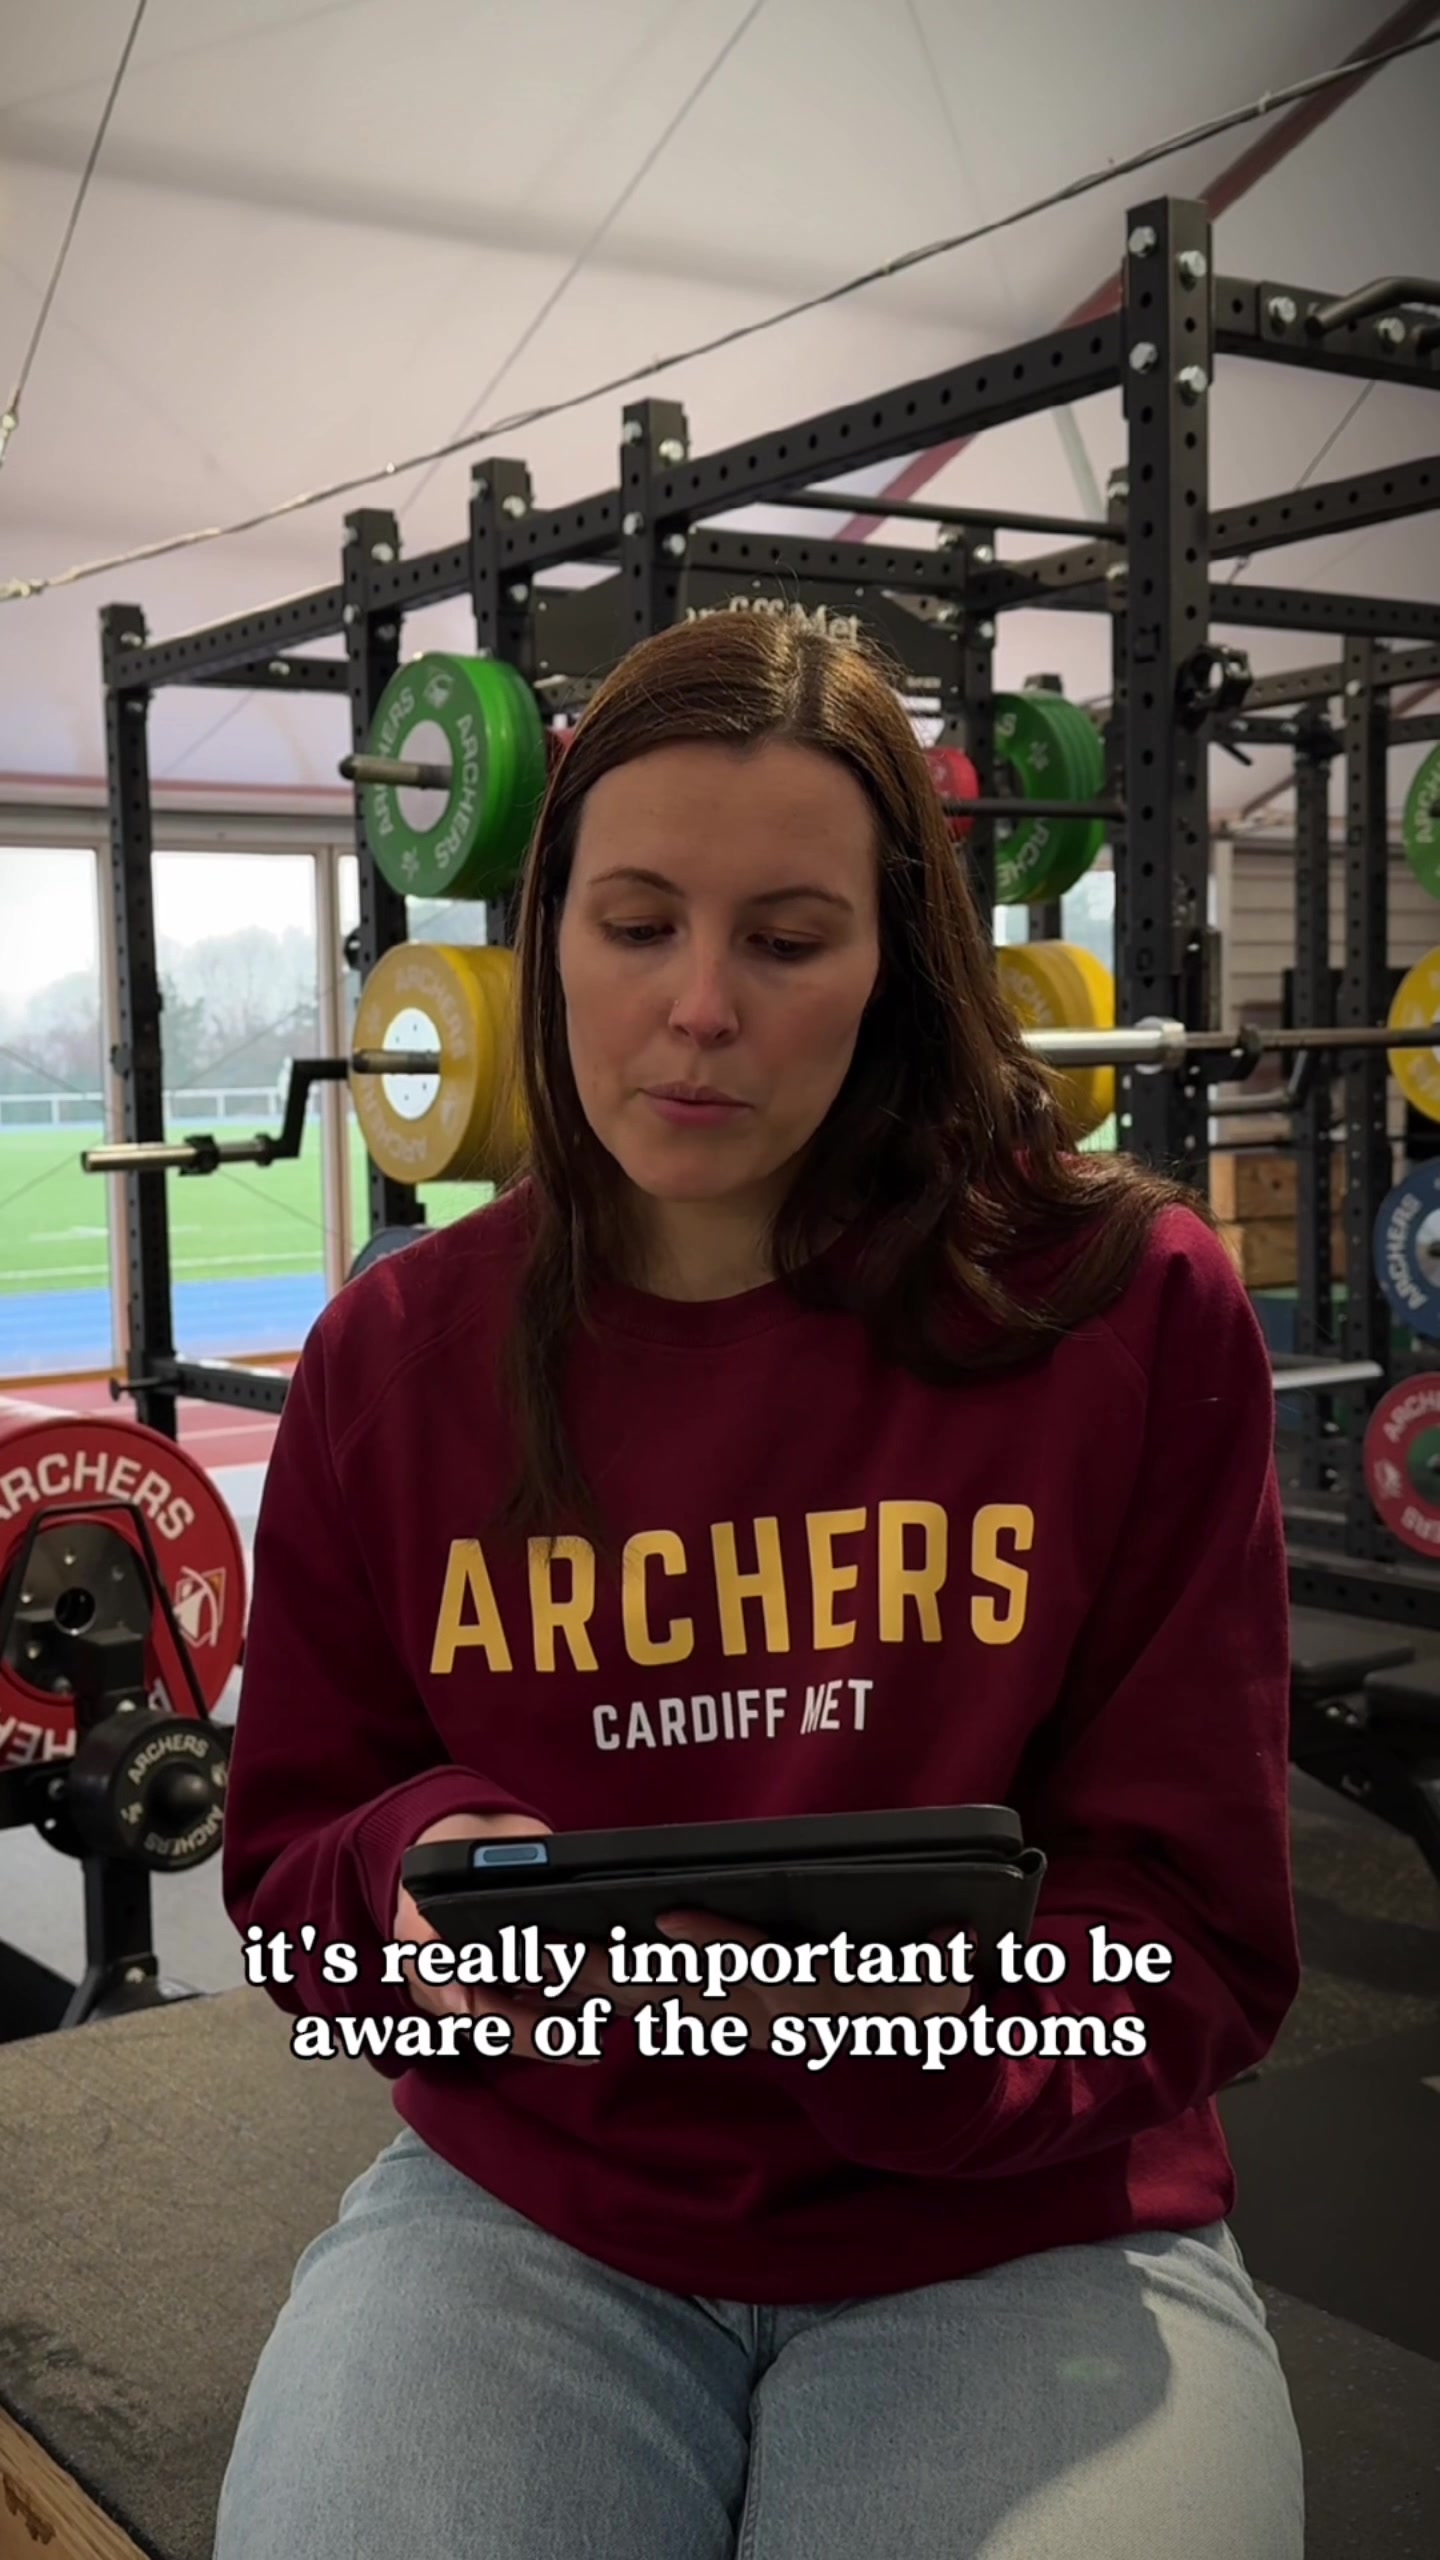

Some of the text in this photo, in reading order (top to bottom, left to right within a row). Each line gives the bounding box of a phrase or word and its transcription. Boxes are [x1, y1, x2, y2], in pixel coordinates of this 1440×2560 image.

[434, 714, 480, 870] ARCHERS
[429, 1500, 1034, 1675] ARCHERS
[128, 1733, 209, 1786] ARCHERS
[593, 1679, 875, 1751] CARDIFF MET
